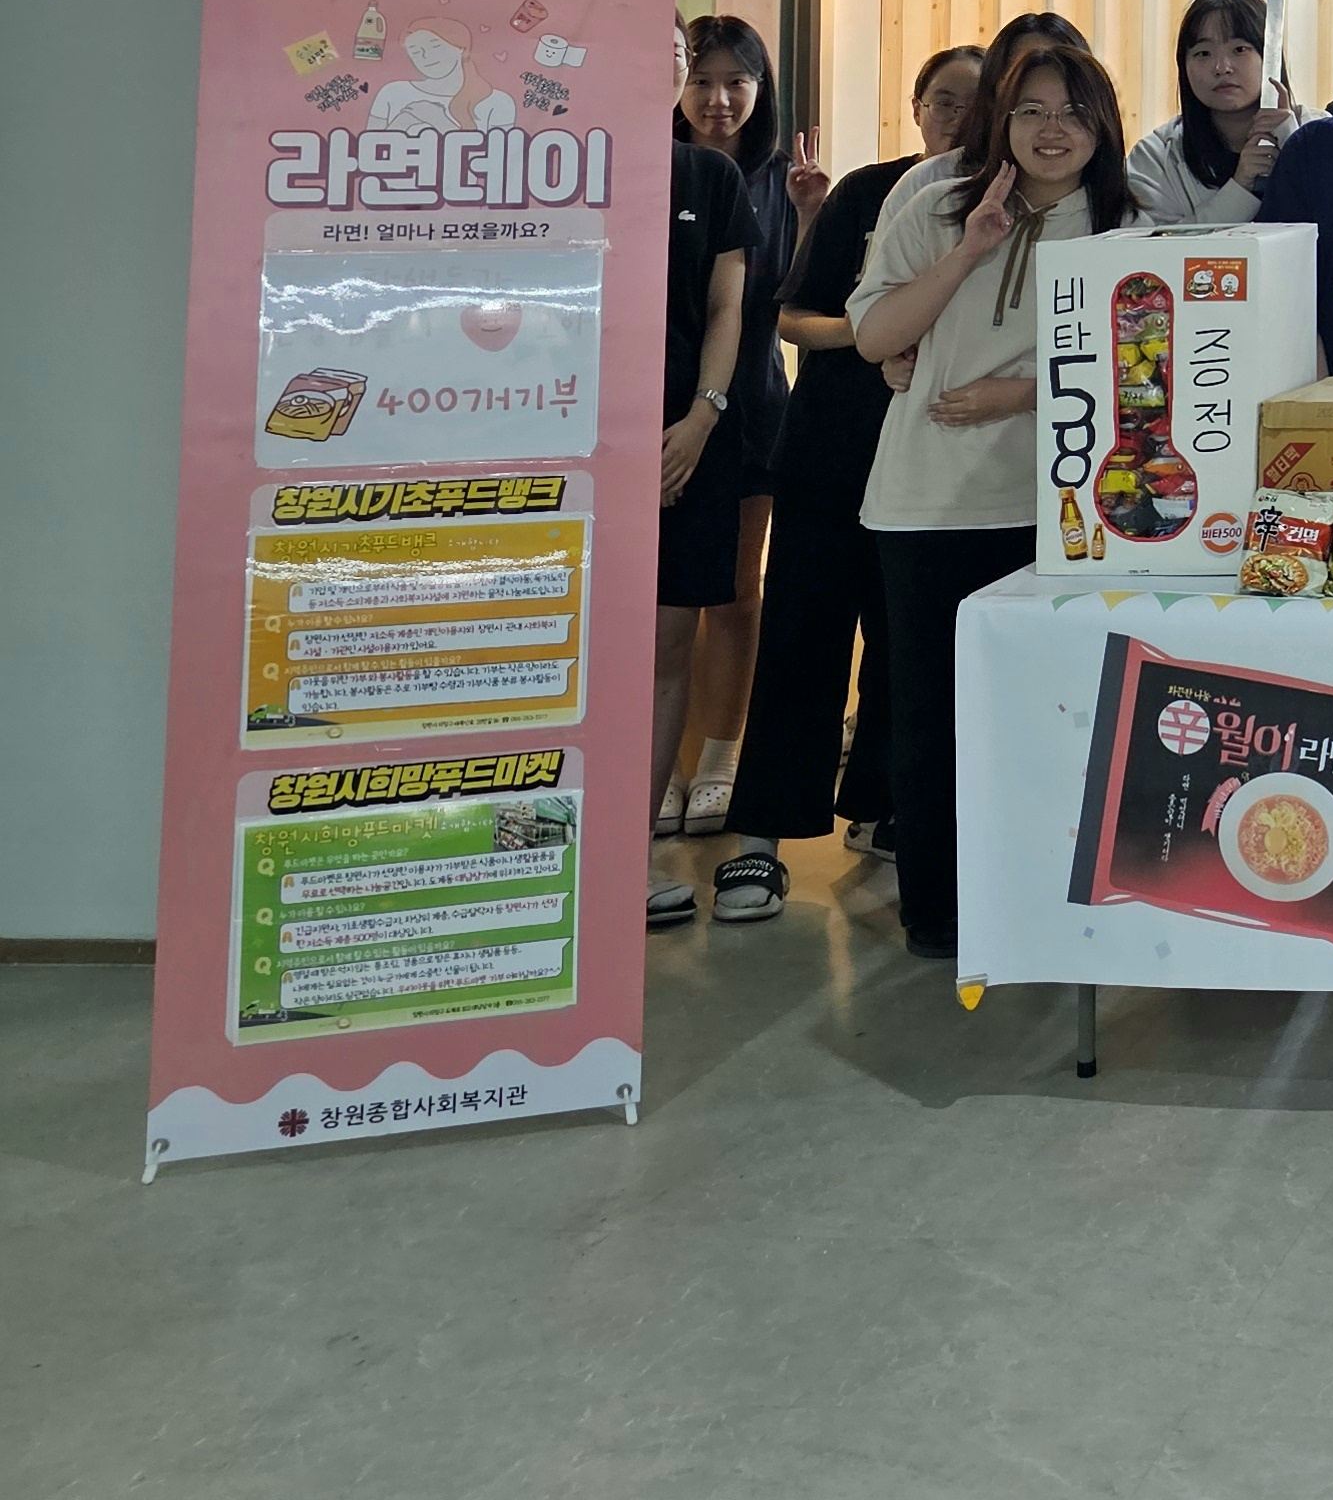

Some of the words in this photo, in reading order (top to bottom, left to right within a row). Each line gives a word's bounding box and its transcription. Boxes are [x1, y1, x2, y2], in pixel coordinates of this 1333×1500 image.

[265, 127, 612, 210] 라면데이
[322, 222, 369, 242] 라면!
[376, 223, 435, 241] 얼마나
[441, 221, 551, 242] 모였을까요?
[1189, 328, 1232, 453] 증정
[272, 476, 565, 526] 창원시기초푸드뱅크
[1285, 525, 1320, 545] 건면
[264, 615, 281, 634] Q
[262, 662, 280, 682] Q
[270, 750, 565, 815] 창원시희망푸드마켓
[254, 815, 438, 856] 창원시희망푸드마켓
[257, 858, 275, 877] Q
[256, 907, 274, 927] Q
[254, 956, 272, 975] Q
[320, 1083, 528, 1130] 창원종합사회복지관
